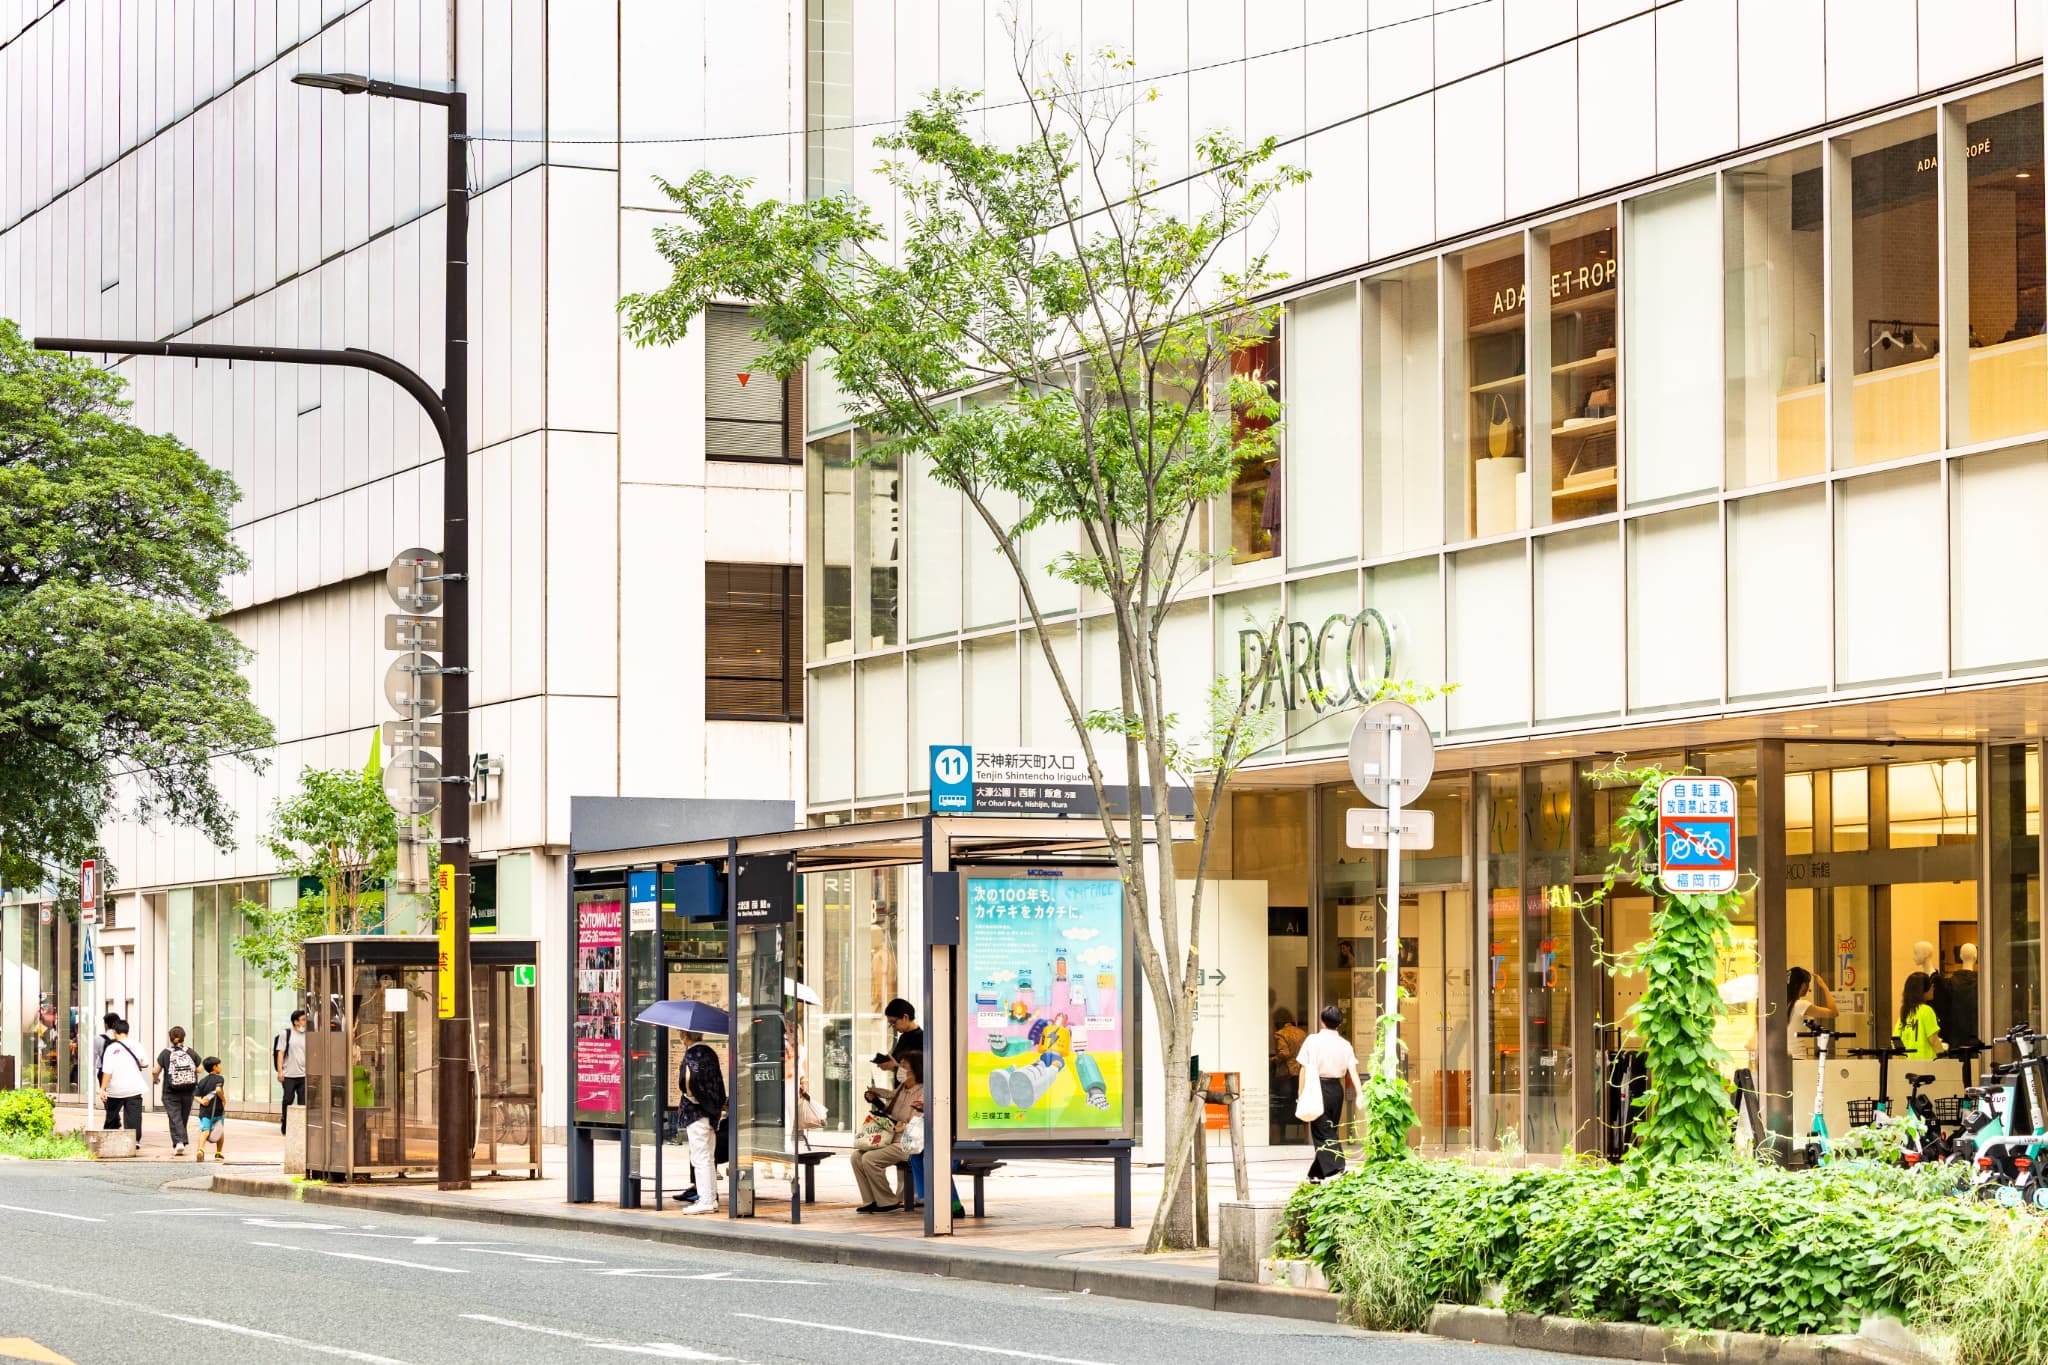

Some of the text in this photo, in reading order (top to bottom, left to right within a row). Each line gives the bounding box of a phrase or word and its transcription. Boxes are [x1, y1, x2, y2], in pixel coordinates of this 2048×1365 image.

[1917, 156, 1938, 173] ADA
[1493, 259, 1617, 315] ADA ET ROP
[1238, 608, 1391, 716] PARCO
[941, 756, 961, 776] 11
[976, 753, 1075, 770] 天神新天町入口
[976, 771, 1003, 782] Tenjin
[1006, 771, 1055, 781] Shintencho
[1674, 784, 1721, 798] 自転車
[1667, 800, 1729, 814] 放置禁止区域
[1677, 873, 1720, 888] 福岡市
